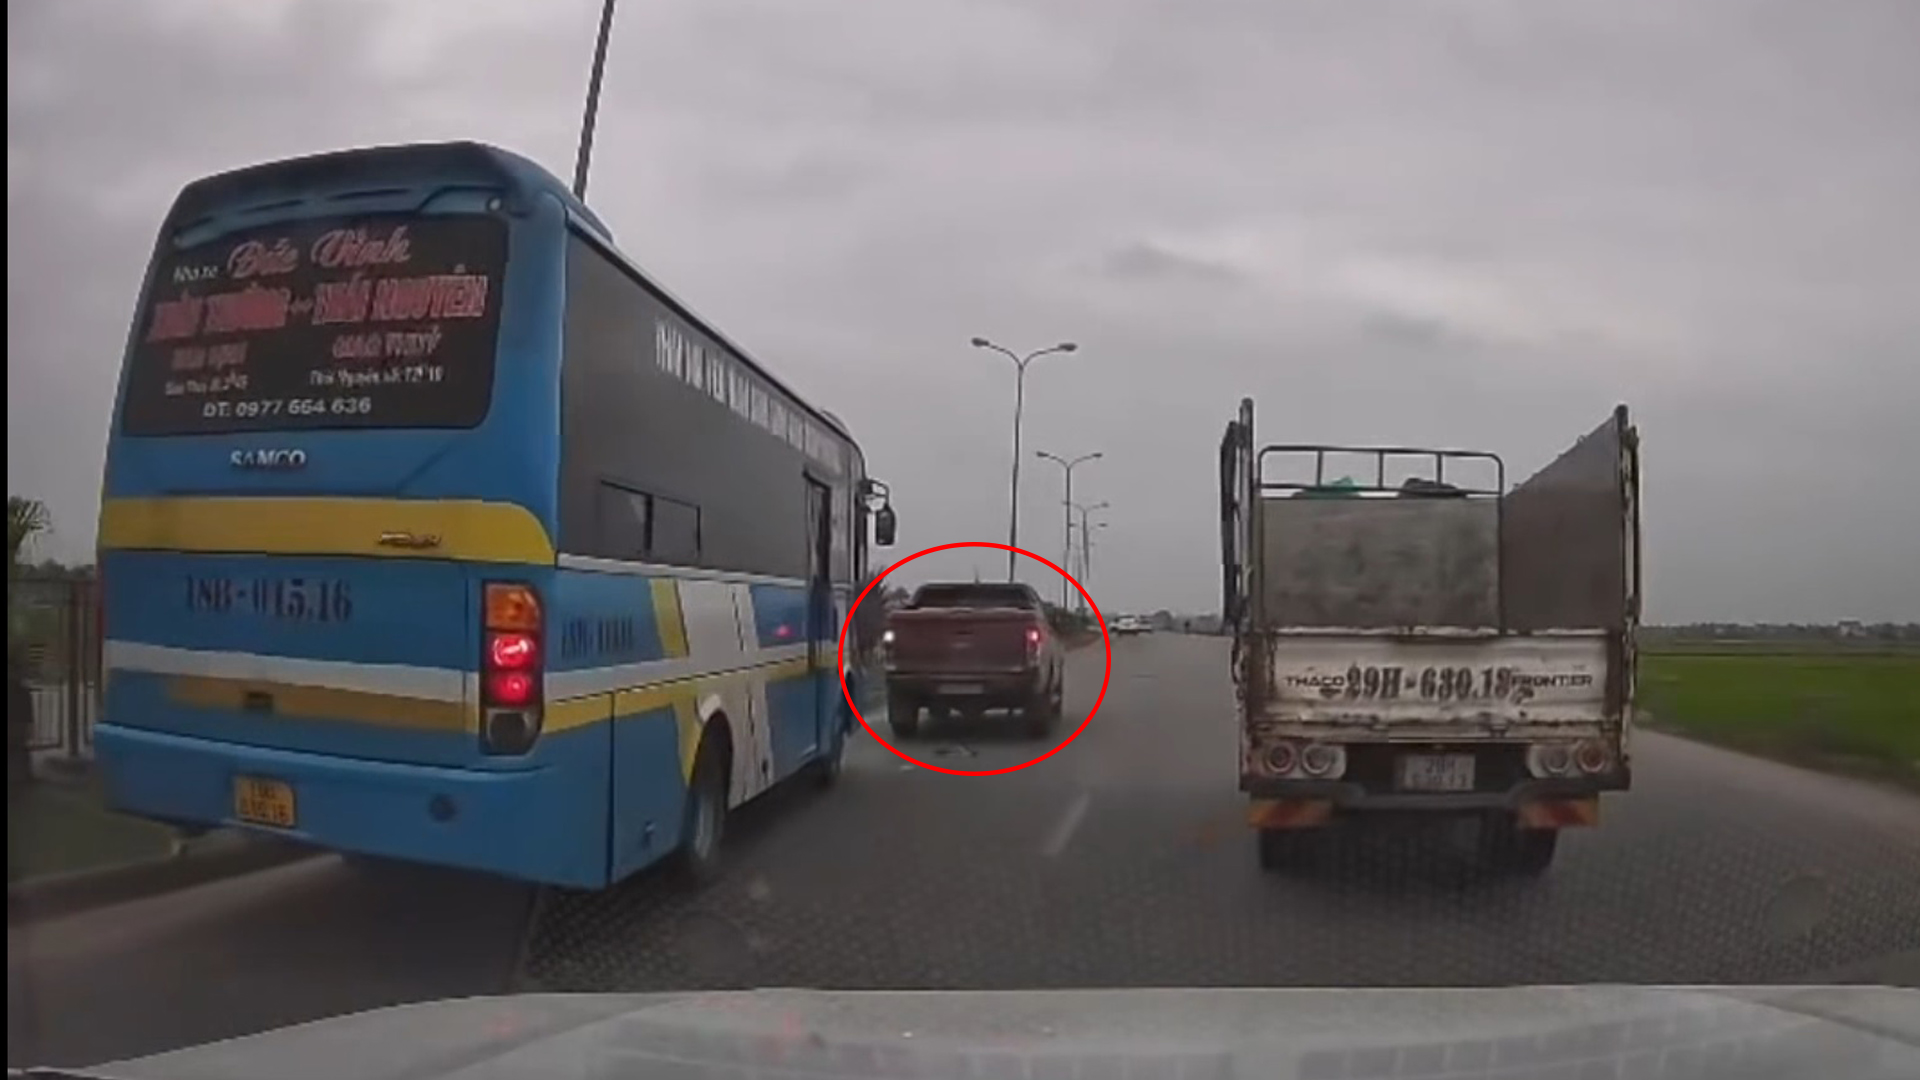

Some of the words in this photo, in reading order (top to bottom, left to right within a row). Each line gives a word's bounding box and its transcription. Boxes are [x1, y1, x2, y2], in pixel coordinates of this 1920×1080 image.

[235, 399, 284, 418] 0977
[330, 396, 372, 414] 636
[229, 448, 307, 467] SAMCO
[1285, 675, 1345, 687] THACO
[1511, 673, 1593, 688] FRONTIER
